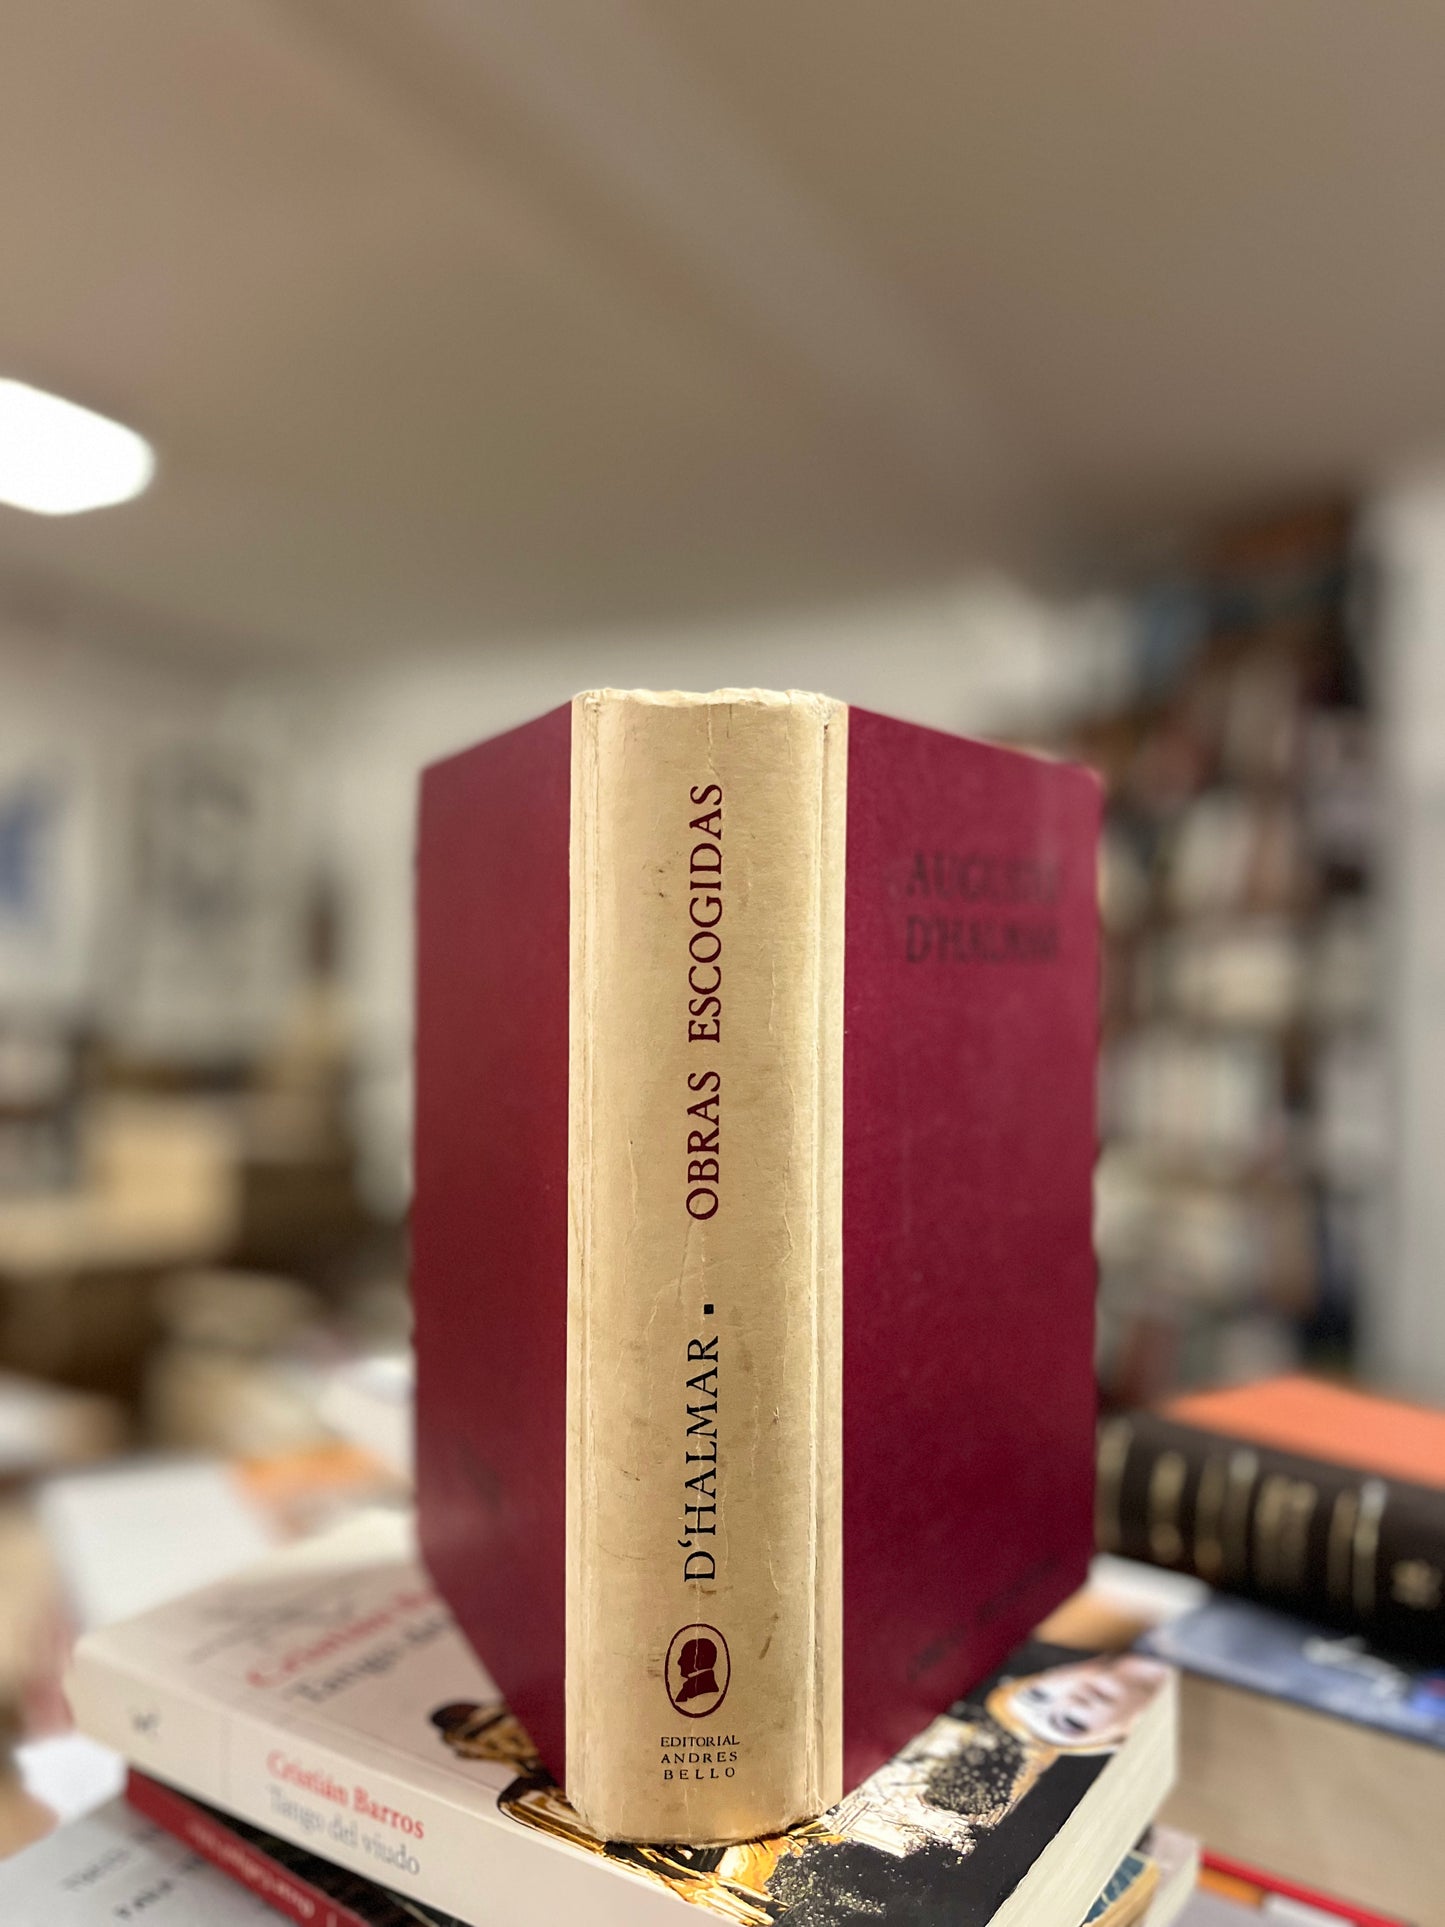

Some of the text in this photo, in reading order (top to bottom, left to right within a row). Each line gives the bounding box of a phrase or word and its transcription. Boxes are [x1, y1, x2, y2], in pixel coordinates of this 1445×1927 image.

[687, 783, 723, 1044] ESCOGIDAS
[685, 1071, 721, 1221] OBRAS
[660, 1734, 741, 1748] EDITORIAL
[660, 1751, 738, 1764] ANDRES
[663, 1766, 736, 1780] BELLO
[353, 1785, 425, 1840] Barros
